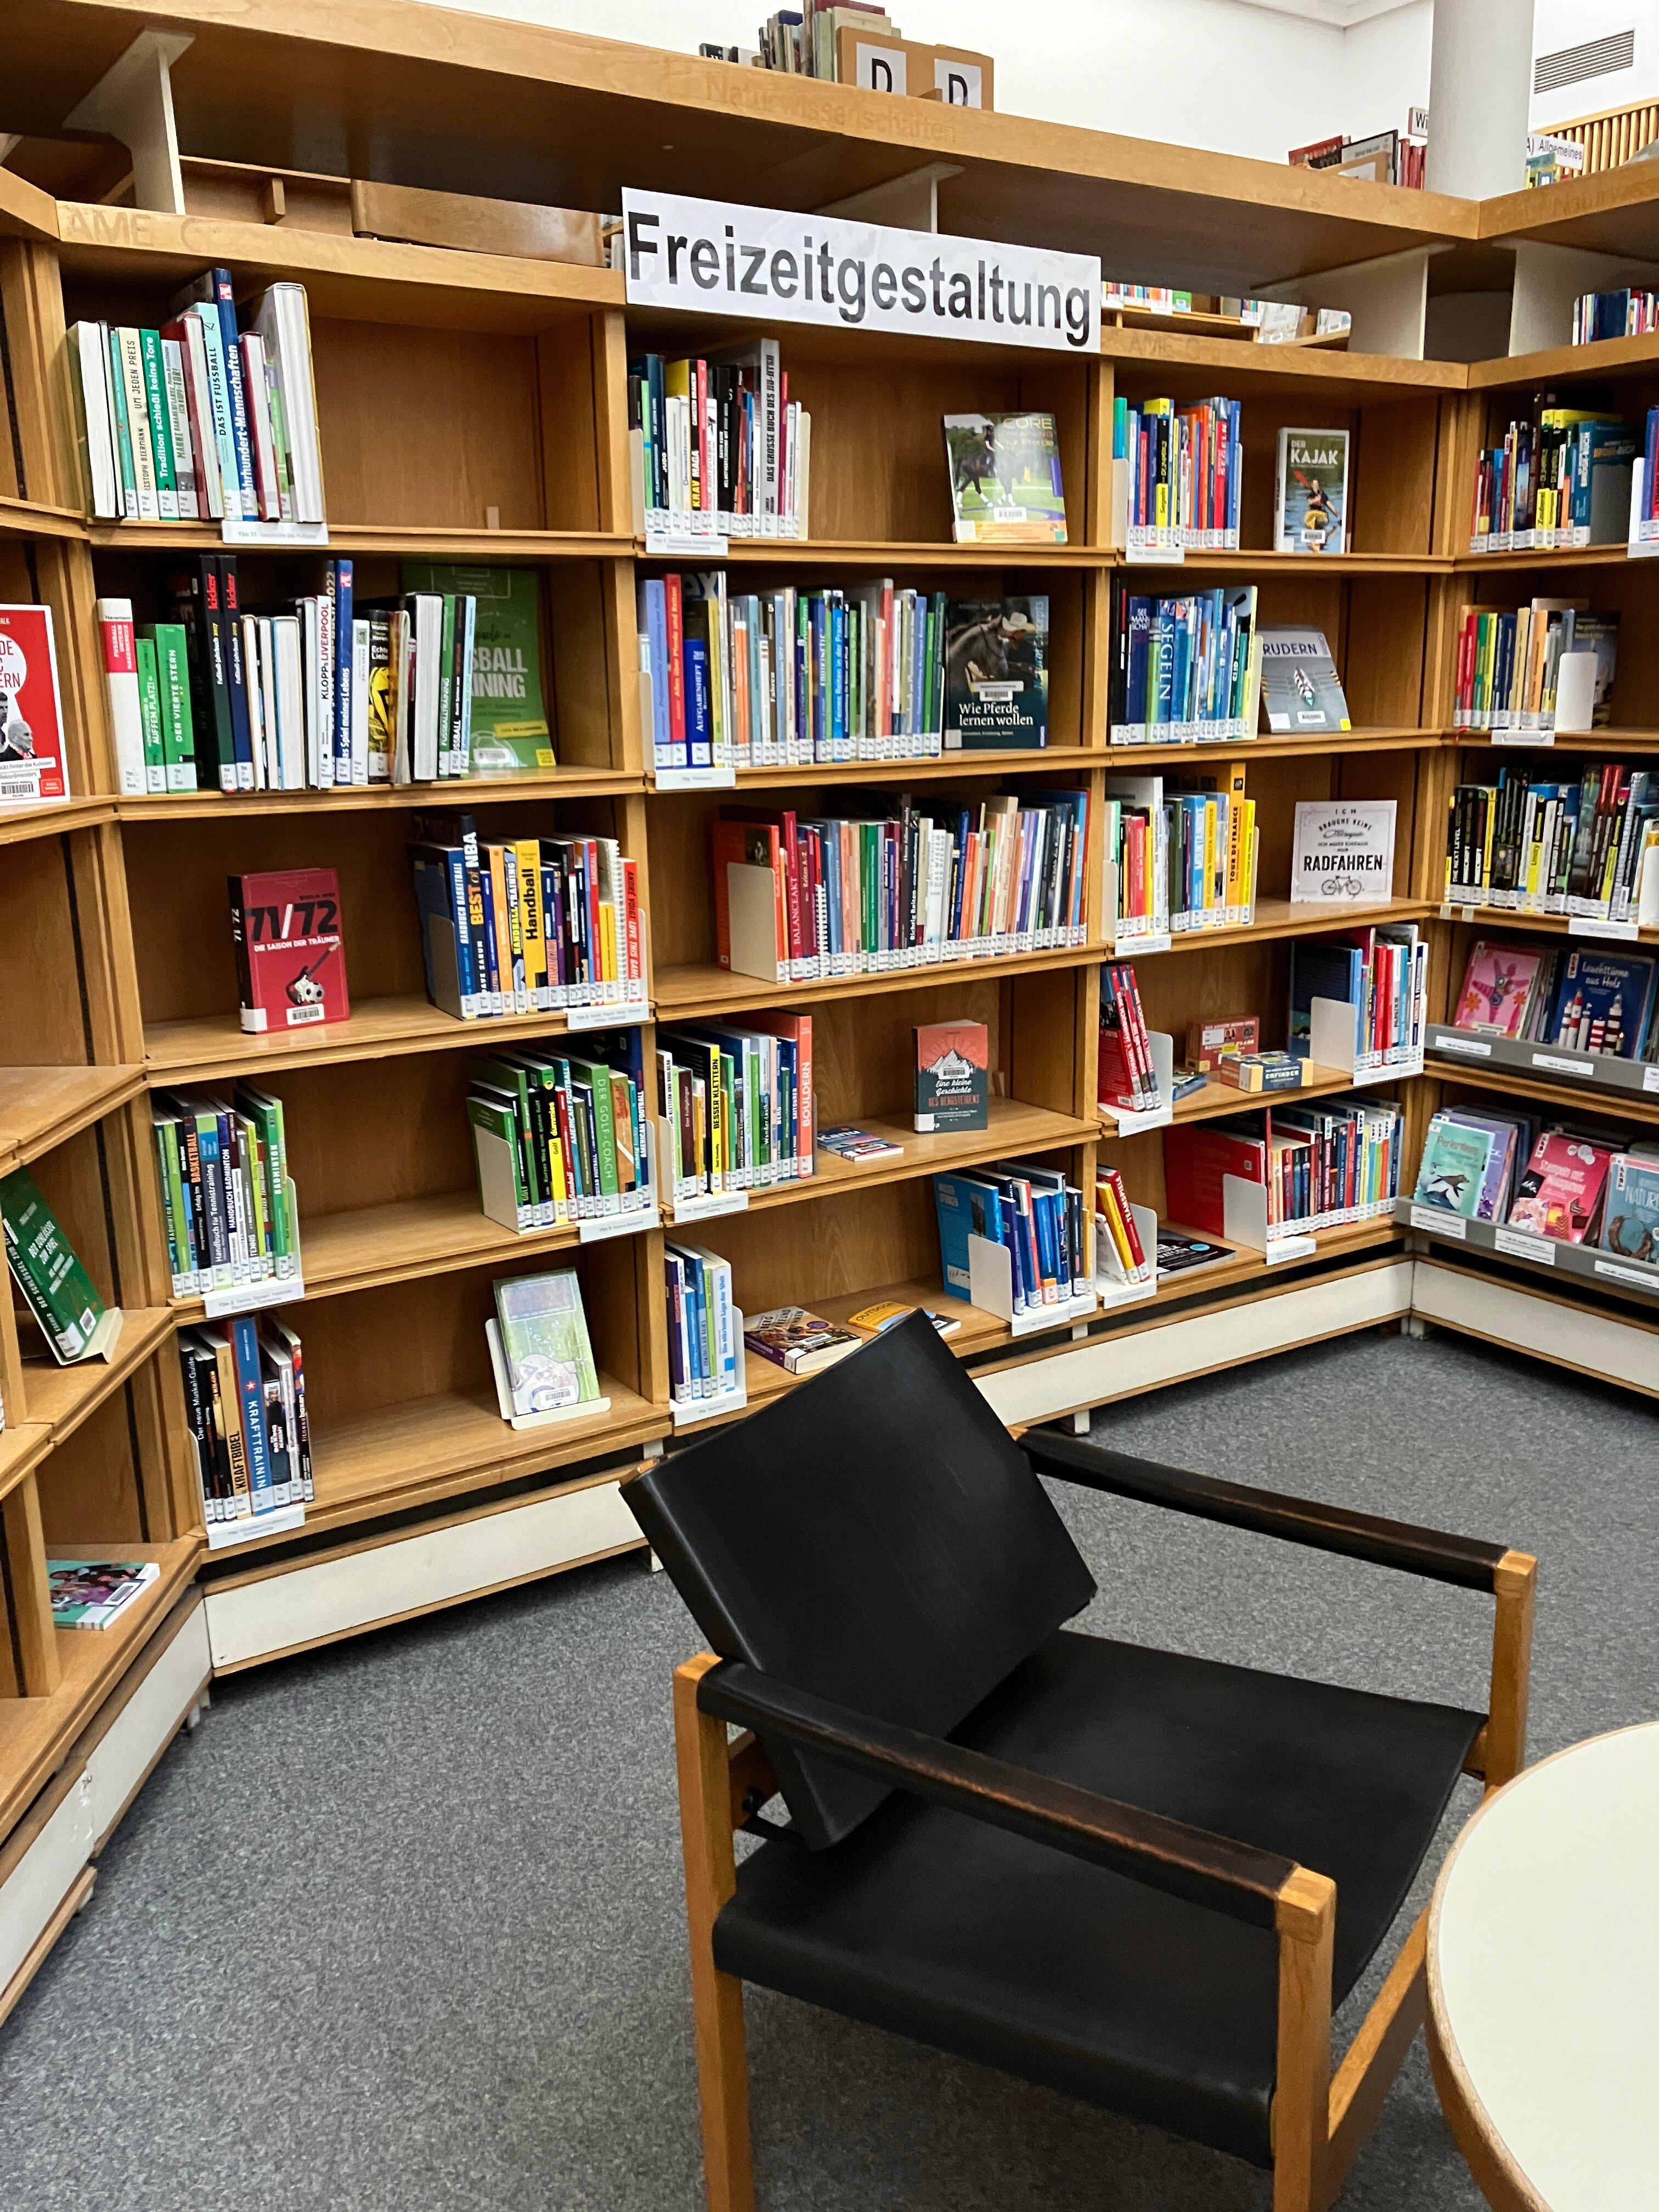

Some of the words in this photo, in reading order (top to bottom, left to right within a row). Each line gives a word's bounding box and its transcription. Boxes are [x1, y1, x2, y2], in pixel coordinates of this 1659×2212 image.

[948, 73, 968, 106] D
[1538, 141, 1583, 161] Allgemeines
[628, 211, 1091, 347] Freizeitgestaltung
[126, 340, 137, 365] PREIS
[145, 336, 154, 359] Tore
[129, 369, 140, 394] JEDEN
[149, 362, 159, 390] keine
[209, 347, 221, 396] FUSSBALL
[133, 398, 142, 409] UM
[151, 393, 163, 431] schießt
[215, 399, 224, 413] IST
[766, 393, 775, 409] DES
[217, 416, 227, 436] DAS
[227, 345, 255, 496] ahrhundert-Mannschaften
[766, 410, 775, 432] BUCH
[138, 427, 147, 461] BIERMANN
[157, 433, 168, 478] Tradition
[766, 433, 775, 465] GROSSE
[1290, 448, 1338, 465] KAJAK
[691, 450, 700, 478] MAGA
[766, 466, 775, 482] DAS
[691, 480, 701, 507] KRAV
[207, 573, 219, 610] kicker
[225, 573, 238, 610] kicker
[320, 603, 329, 661] LIVERPOOL
[168, 649, 178, 681] STERN
[1159, 622, 1175, 700] SEGELN
[1263, 642, 1317, 656] RUDERN
[340, 667, 350, 697] Lebens
[695, 664, 704, 732] AUFGABENHEFT
[171, 685, 180, 719] VIERTE
[341, 697, 350, 726] meines
[440, 676, 450, 747] FUSSBALLTRAINING
[958, 702, 980, 714] Wie
[983, 702, 1020, 714] Pferde
[174, 722, 183, 742] DER
[958, 713, 994, 726] lernen
[996, 714, 1034, 726] wollen
[340, 727, 350, 748] Spiel
[1318, 818, 1350, 832] BRAUCHE
[1353, 819, 1372, 831] KEINE
[462, 831, 479, 868] NBA
[1231, 844, 1237, 855] DE
[1304, 855, 1383, 871] RADFAHREN
[453, 862, 466, 905] BASKETBALL
[467, 869, 480, 884] of
[467, 884, 484, 926] BEST
[521, 868, 538, 940] Handball
[789, 876, 801, 945] BALANCEAKT
[247, 900, 338, 942] 71/72
[458, 906, 470, 944] HANDBUCH
[254, 944, 266, 952] DIE
[267, 941, 292, 951] SAISON
[294, 939, 307, 948] DER
[563, 1065, 573, 1105] FOOTBALL
[597, 1078, 606, 1100] DER
[802, 1061, 811, 1127] BOULDERN
[935, 1087, 972, 1097] Geschichte
[951, 1079, 972, 1087] kleine
[549, 1102, 558, 1136] dummies
[637, 1090, 646, 1122] FOOTBALL
[568, 1105, 577, 1145] AMERICAN
[638, 1123, 647, 1158] AMERICAN
[187, 1132, 201, 1183] BASKETBALL
[222, 1149, 232, 1190] BADMINTON
[270, 1144, 281, 1195] BADMINTON
[206, 1164, 218, 1215] Tennistraining
[521, 1186, 529, 1201] GOLF
[566, 1171, 576, 1200] Baseball
[194, 1194, 202, 1211] Erfolg
[225, 1191, 236, 1229] HANDBUCH
[212, 1226, 223, 1262] Handbuch
[248, 1234, 258, 1257] TENNIS
[16, 1260, 40, 1295] SCHLÜSSEL
[36, 1295, 48, 1308] DER
[229, 1431, 246, 1489] KRAFTBIBEL
[248, 1400, 267, 1488] KRAFTTRAININ
